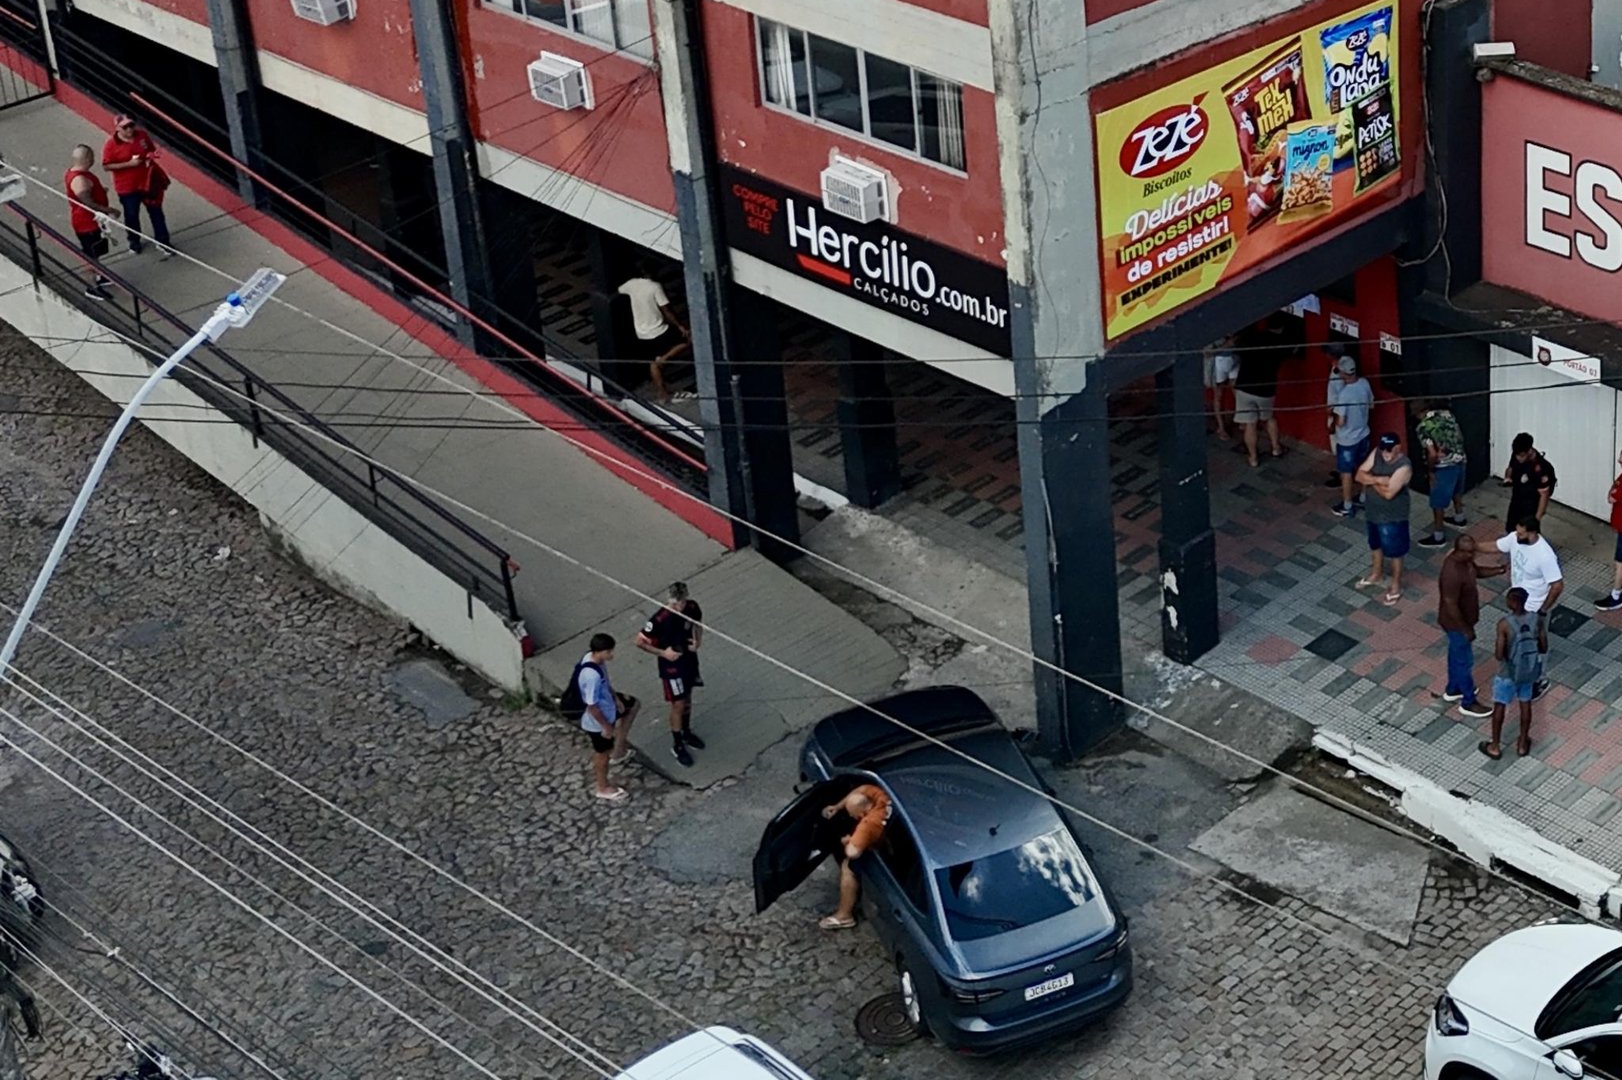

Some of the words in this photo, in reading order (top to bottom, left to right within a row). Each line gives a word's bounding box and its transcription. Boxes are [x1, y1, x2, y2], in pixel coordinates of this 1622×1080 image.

[1125, 179, 1222, 241] Delícias
[1143, 167, 1192, 198] Biscoitos
[786, 197, 1008, 328] Hercílio.com.br
[1119, 196, 1232, 264] impossíveis
[1127, 260, 1152, 282] de
[1157, 215, 1229, 267] resistir!
[853, 277, 930, 317] CALÇADOS
[1120, 238, 1233, 306] EXPERIMENTE!
